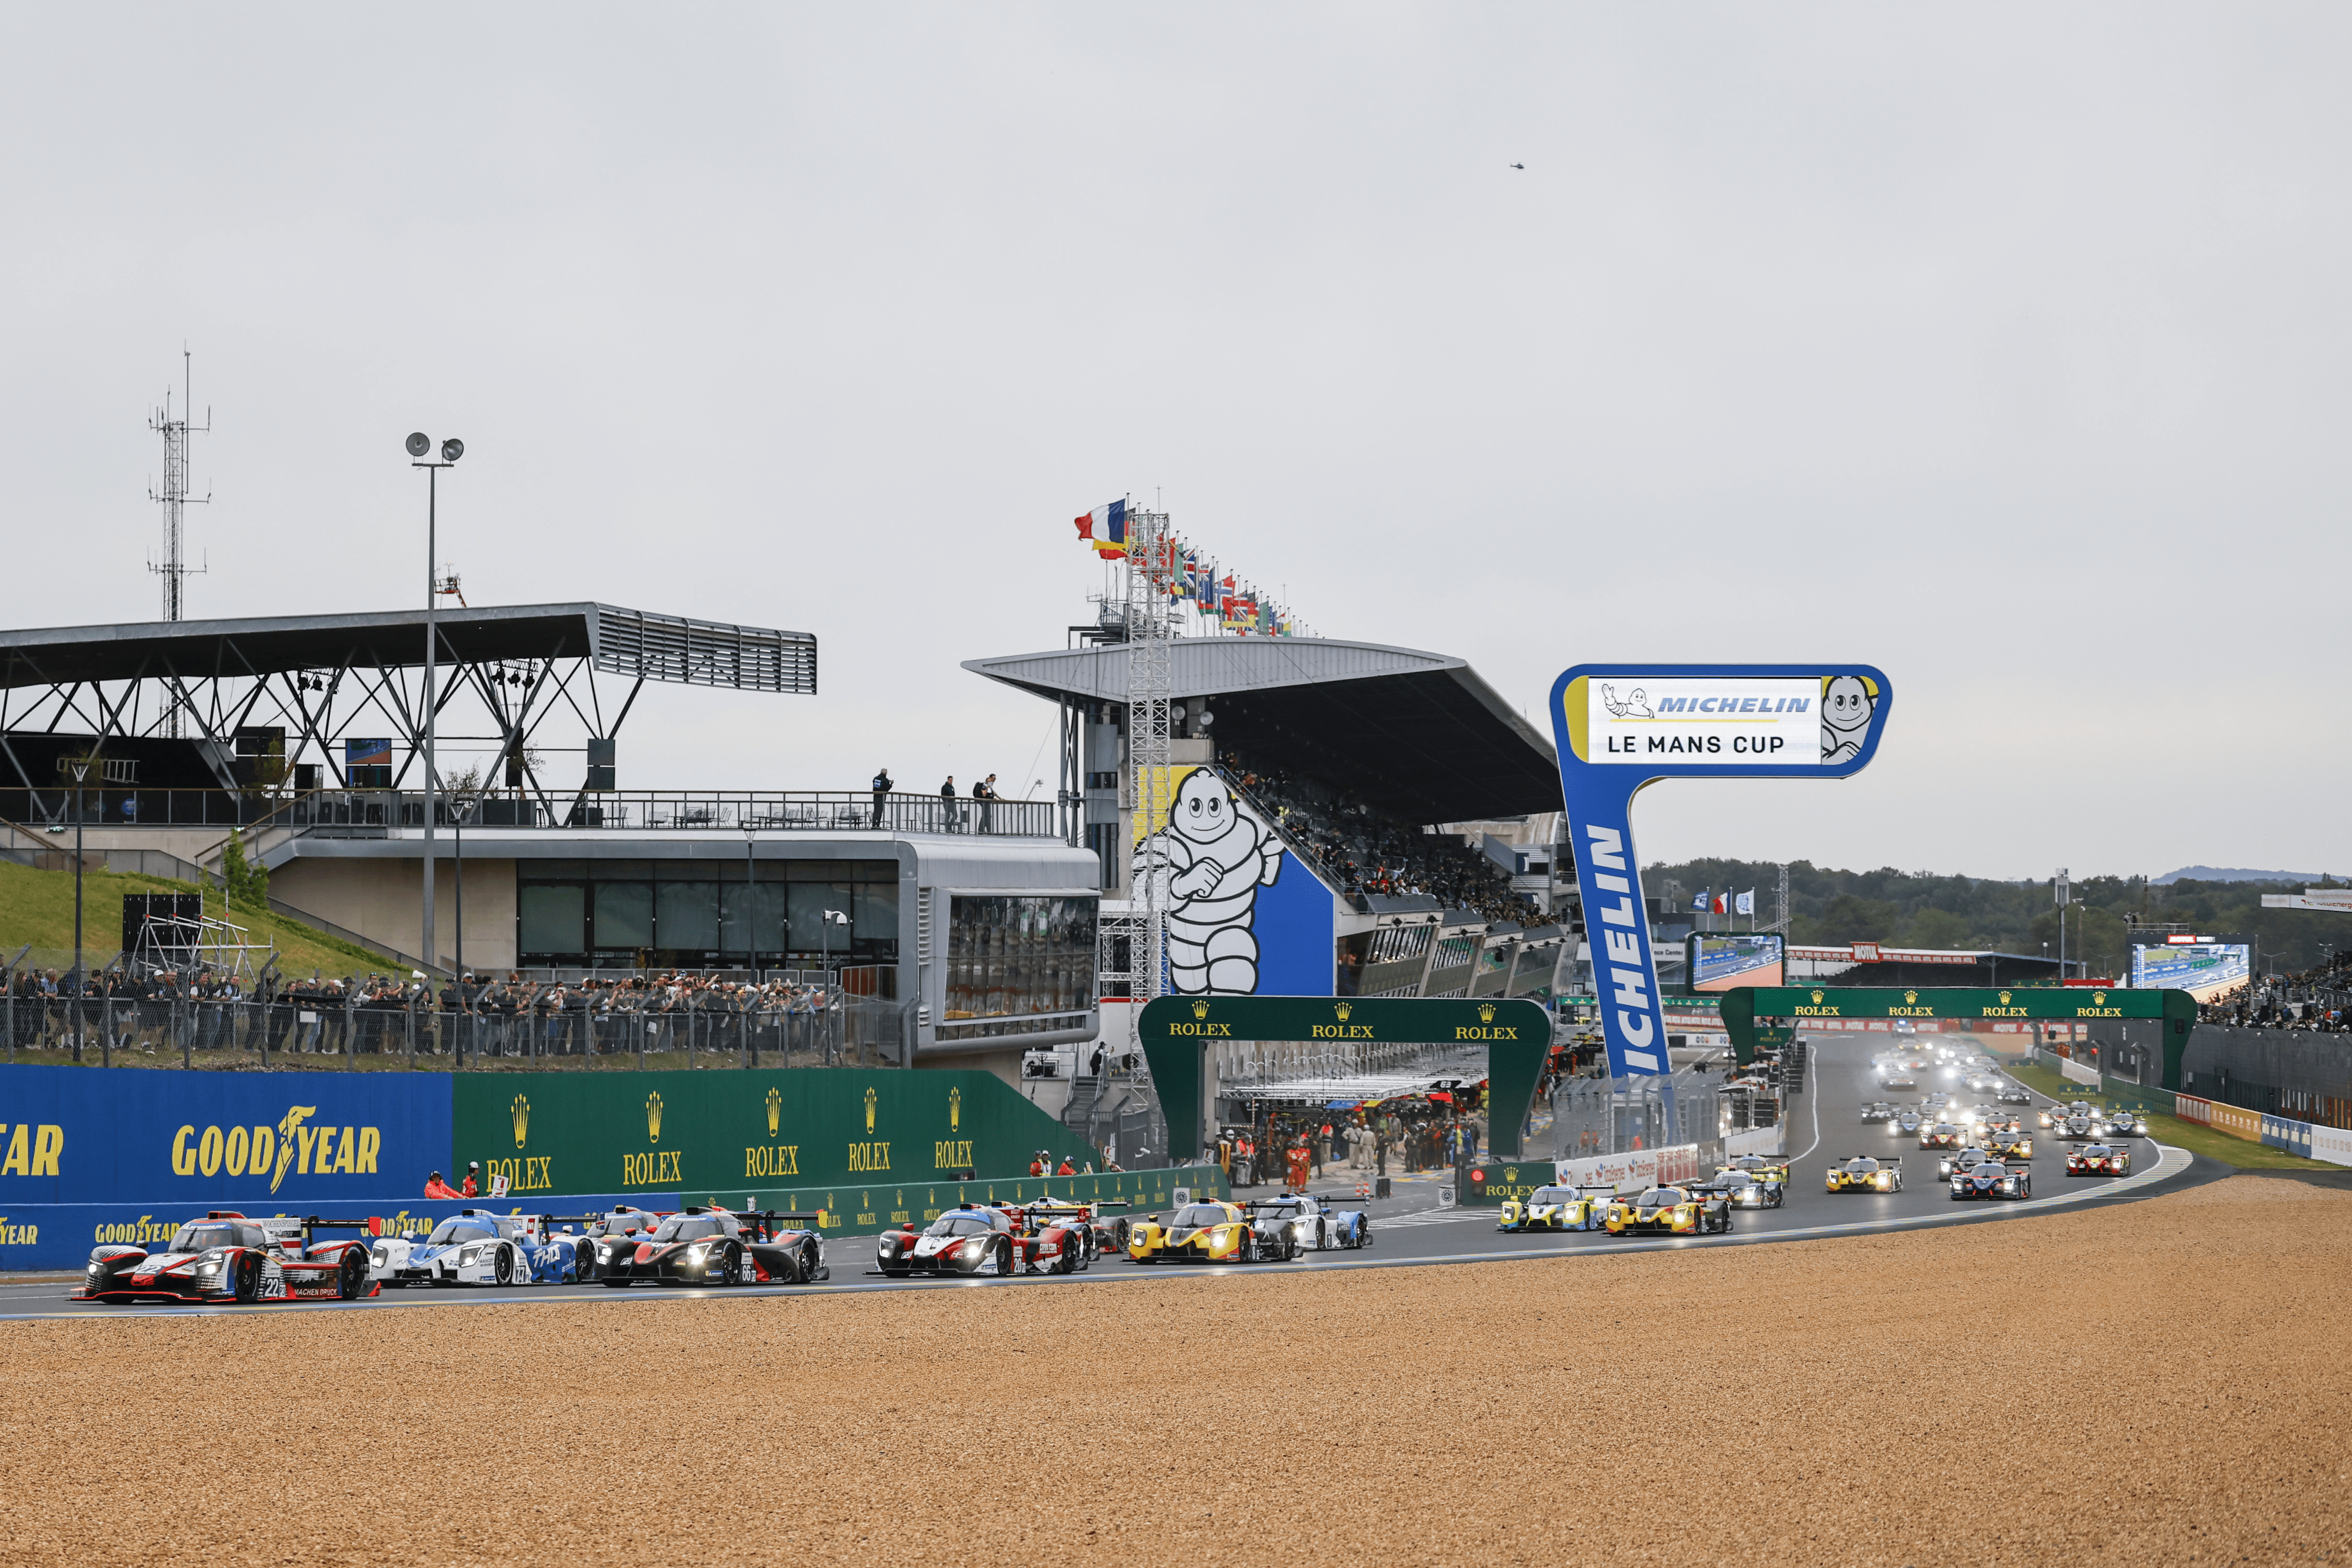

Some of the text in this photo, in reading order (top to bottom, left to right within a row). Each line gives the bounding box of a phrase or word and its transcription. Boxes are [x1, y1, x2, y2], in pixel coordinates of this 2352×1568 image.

[1658, 698, 1811, 712] MICHELIN
[1609, 736, 1784, 753] LE MANS CUP
[1586, 824, 1659, 1080] ICHELIN
[1854, 944, 1878, 960] MOTUL
[1795, 1007, 1840, 1016] ROLEX
[1889, 1007, 1934, 1016] ROLEX
[1982, 1007, 2028, 1017] ROLEX
[2077, 1008, 2122, 1017] ROLEX
[1170, 1023, 1231, 1035] ROLEX
[1312, 1025, 1374, 1038] ROLEX
[1456, 1027, 1518, 1040] ROLEX
[172, 1125, 381, 1177] GOODYEAR
[848, 1142, 891, 1171] ROLEX
[935, 1140, 973, 1169] ROLEX
[623, 1151, 682, 1185] ROLEX
[745, 1146, 799, 1177] ROLEX
[487, 1157, 552, 1192] ROLEX
[1486, 1186, 1536, 1196] ROLEX
[827, 1215, 841, 1227] OLEX
[857, 1213, 877, 1225] ROLEX
[1014, 1258, 1022, 1273] 20
[516, 1266, 525, 1283] 77
[742, 1265, 751, 1282] 66
[264, 1278, 279, 1297] 22
